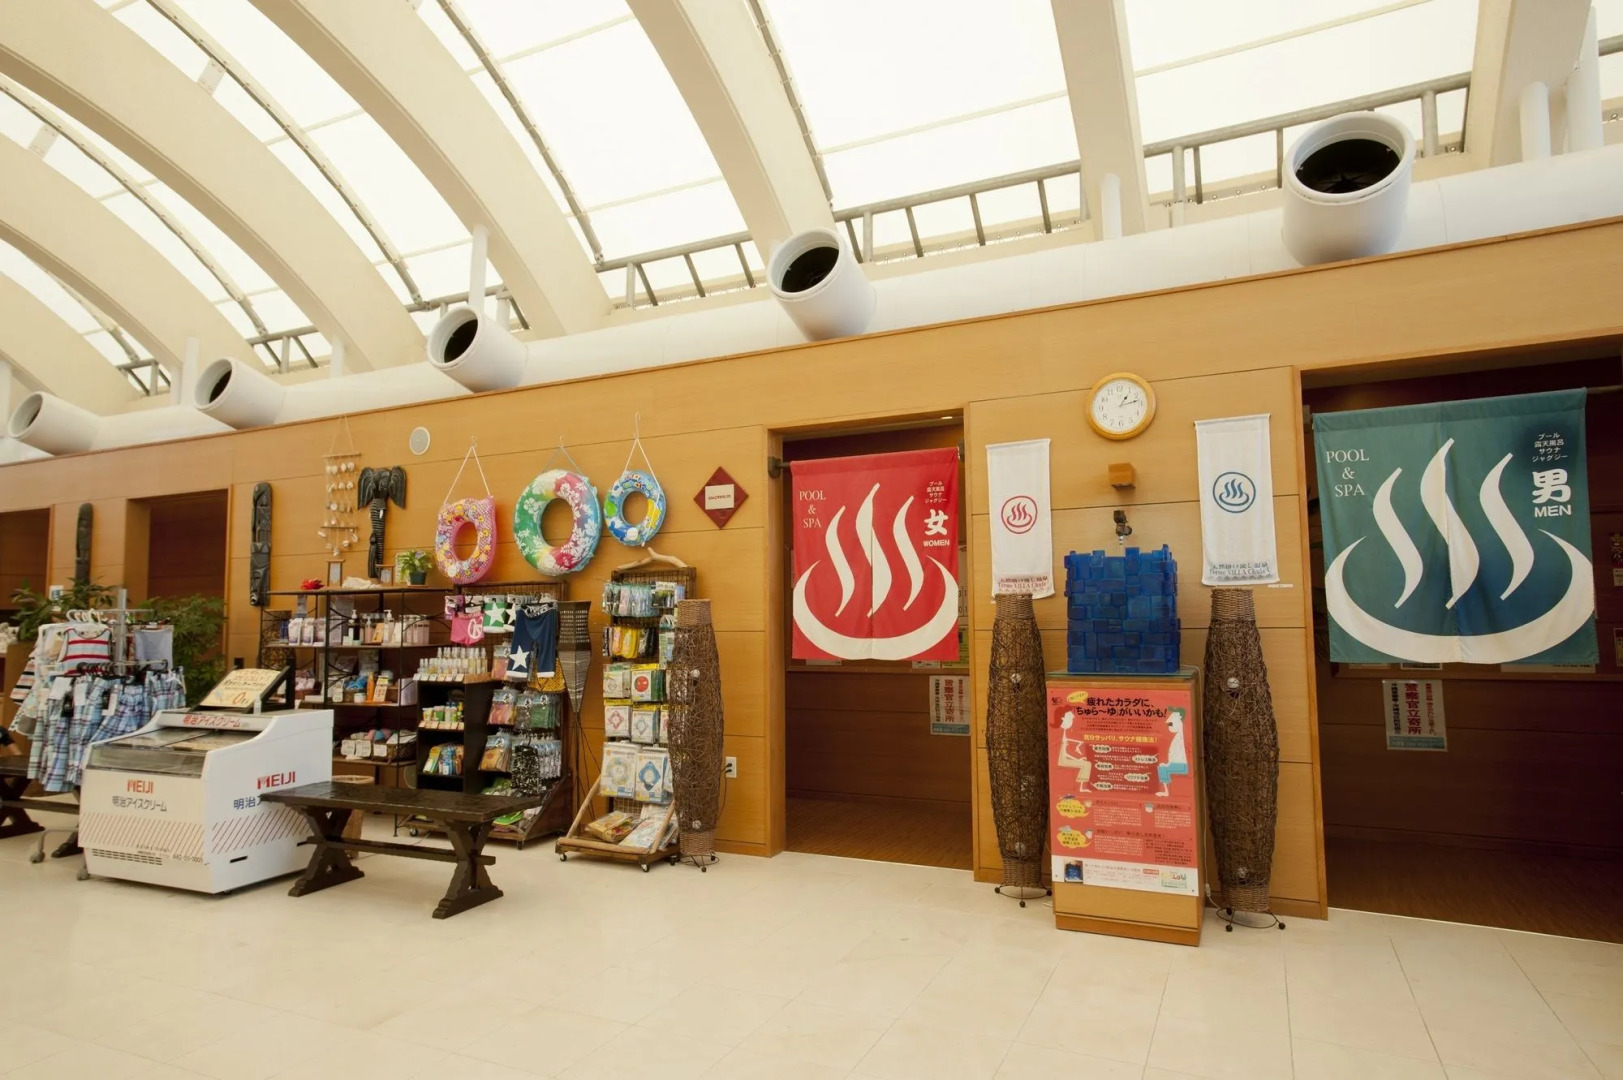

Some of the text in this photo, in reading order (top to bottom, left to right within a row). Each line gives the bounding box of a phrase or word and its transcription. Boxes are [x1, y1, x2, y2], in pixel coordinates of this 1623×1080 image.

[1538, 432, 1560, 440] プール
[1534, 439, 1564, 448] 露天風呂
[1326, 449, 1370, 463] POOL
[1532, 454, 1568, 462] ジャグジー
[1342, 467, 1355, 480] &
[1334, 484, 1366, 498] SPA
[1532, 468, 1571, 504] 男
[799, 489, 826, 501] POOL
[808, 504, 817, 514] &
[1534, 504, 1572, 518] MEN
[803, 517, 822, 528] SPA
[923, 508, 949, 536] 女
[923, 539, 950, 547] WOMEN
[1086, 697, 1155, 708] 疲れたカラダに、
[183, 713, 241, 728] 明治アイスクリーム
[126, 779, 154, 794] MEIJI
[257, 771, 296, 790] MEIJI
[112, 795, 168, 812] 明治アイスクリーム
